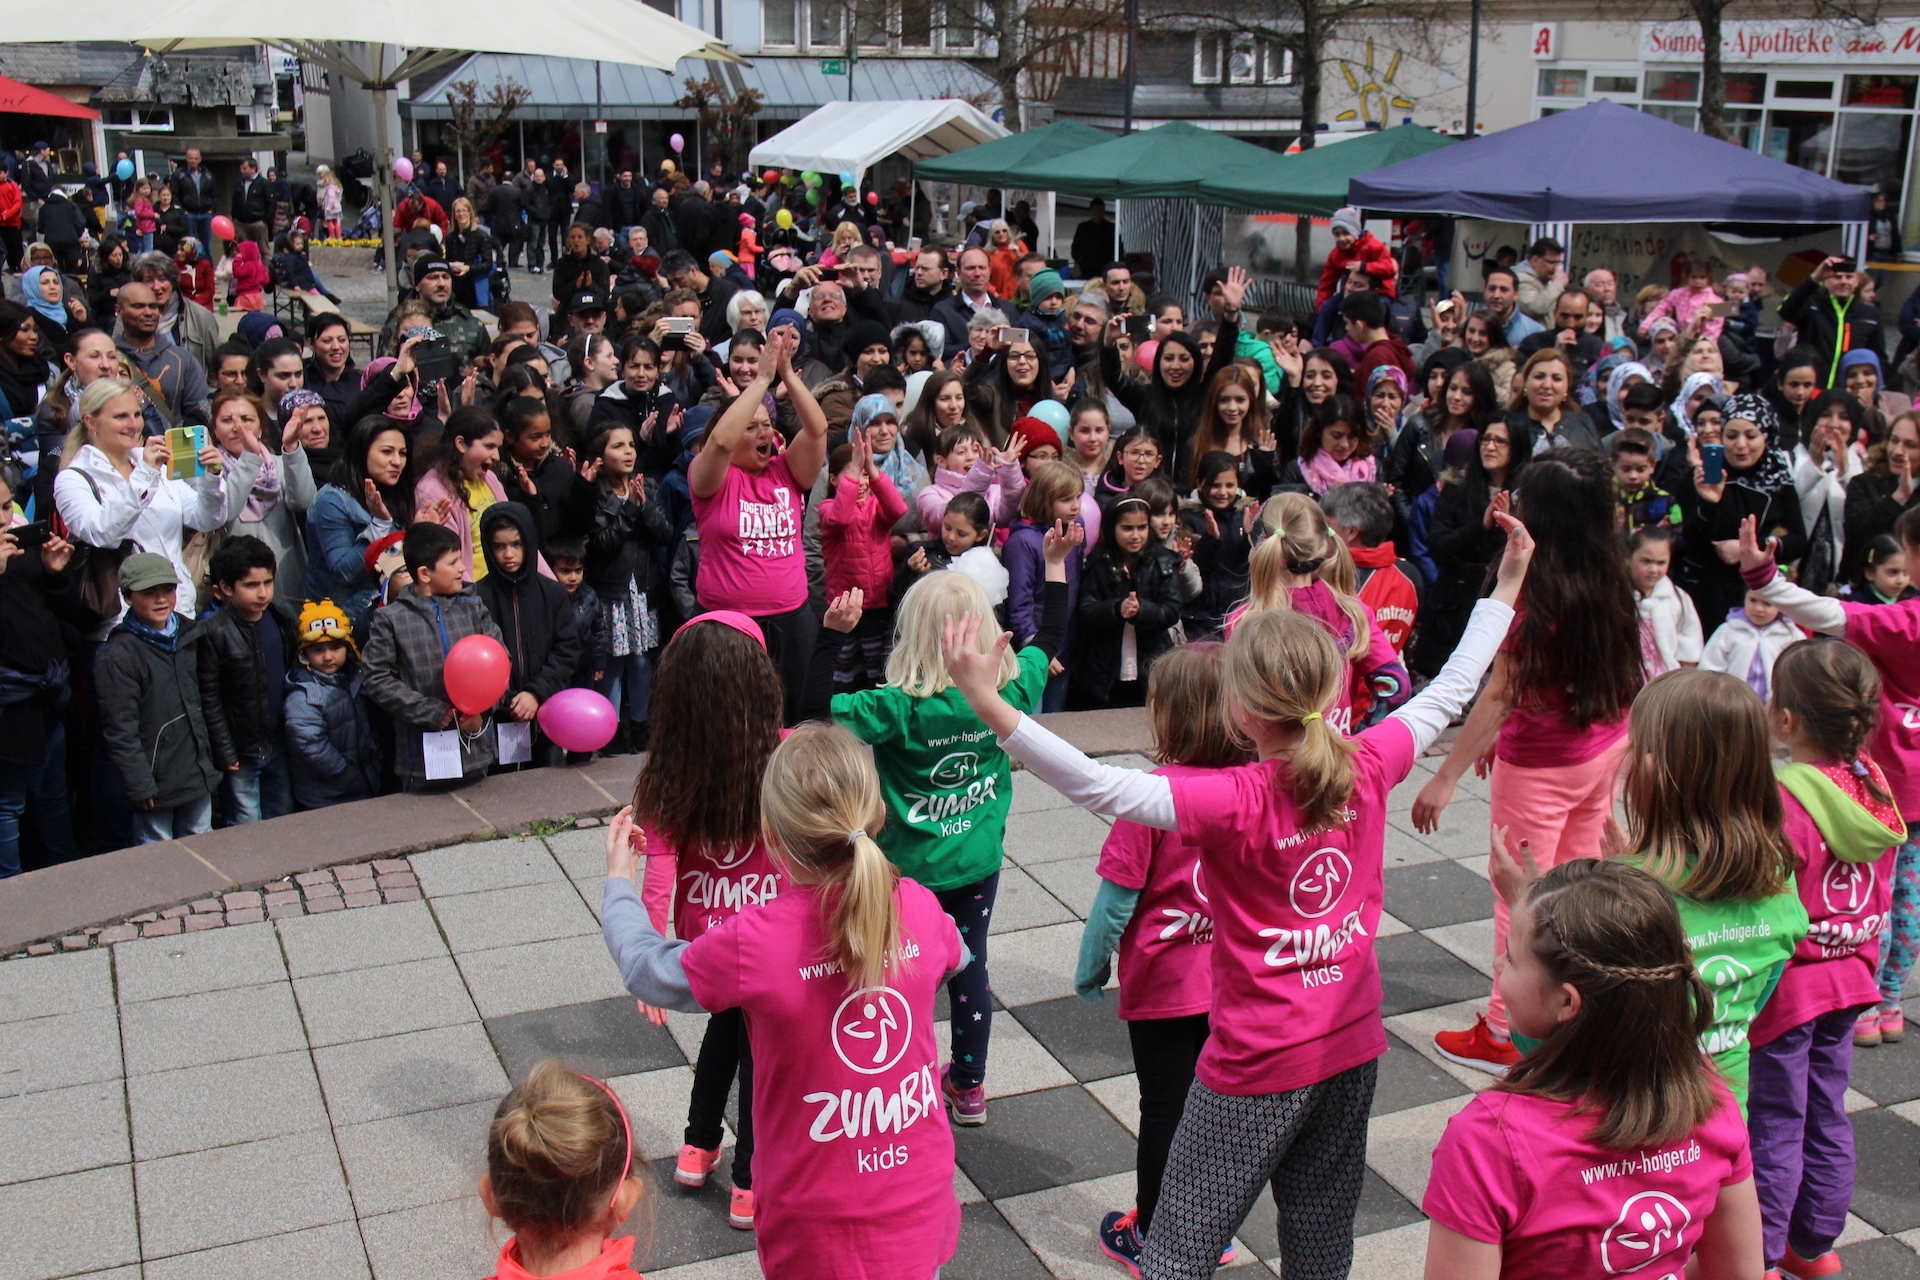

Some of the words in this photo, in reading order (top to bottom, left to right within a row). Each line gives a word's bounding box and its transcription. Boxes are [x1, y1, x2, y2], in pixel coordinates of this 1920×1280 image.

[1533, 27, 1551, 55] A
[1650, 27, 1833, 59] Sonne-Apotheke
[739, 509, 797, 539] DANCE
[927, 728, 996, 748] www.tv-haiger.d
[940, 818, 972, 838] kids
[1301, 963, 1344, 989] kids
[803, 1064, 938, 1143] ZUMBA
[858, 1143, 909, 1174] kids
[1581, 1139, 1701, 1186] www.tv-haiger.de
